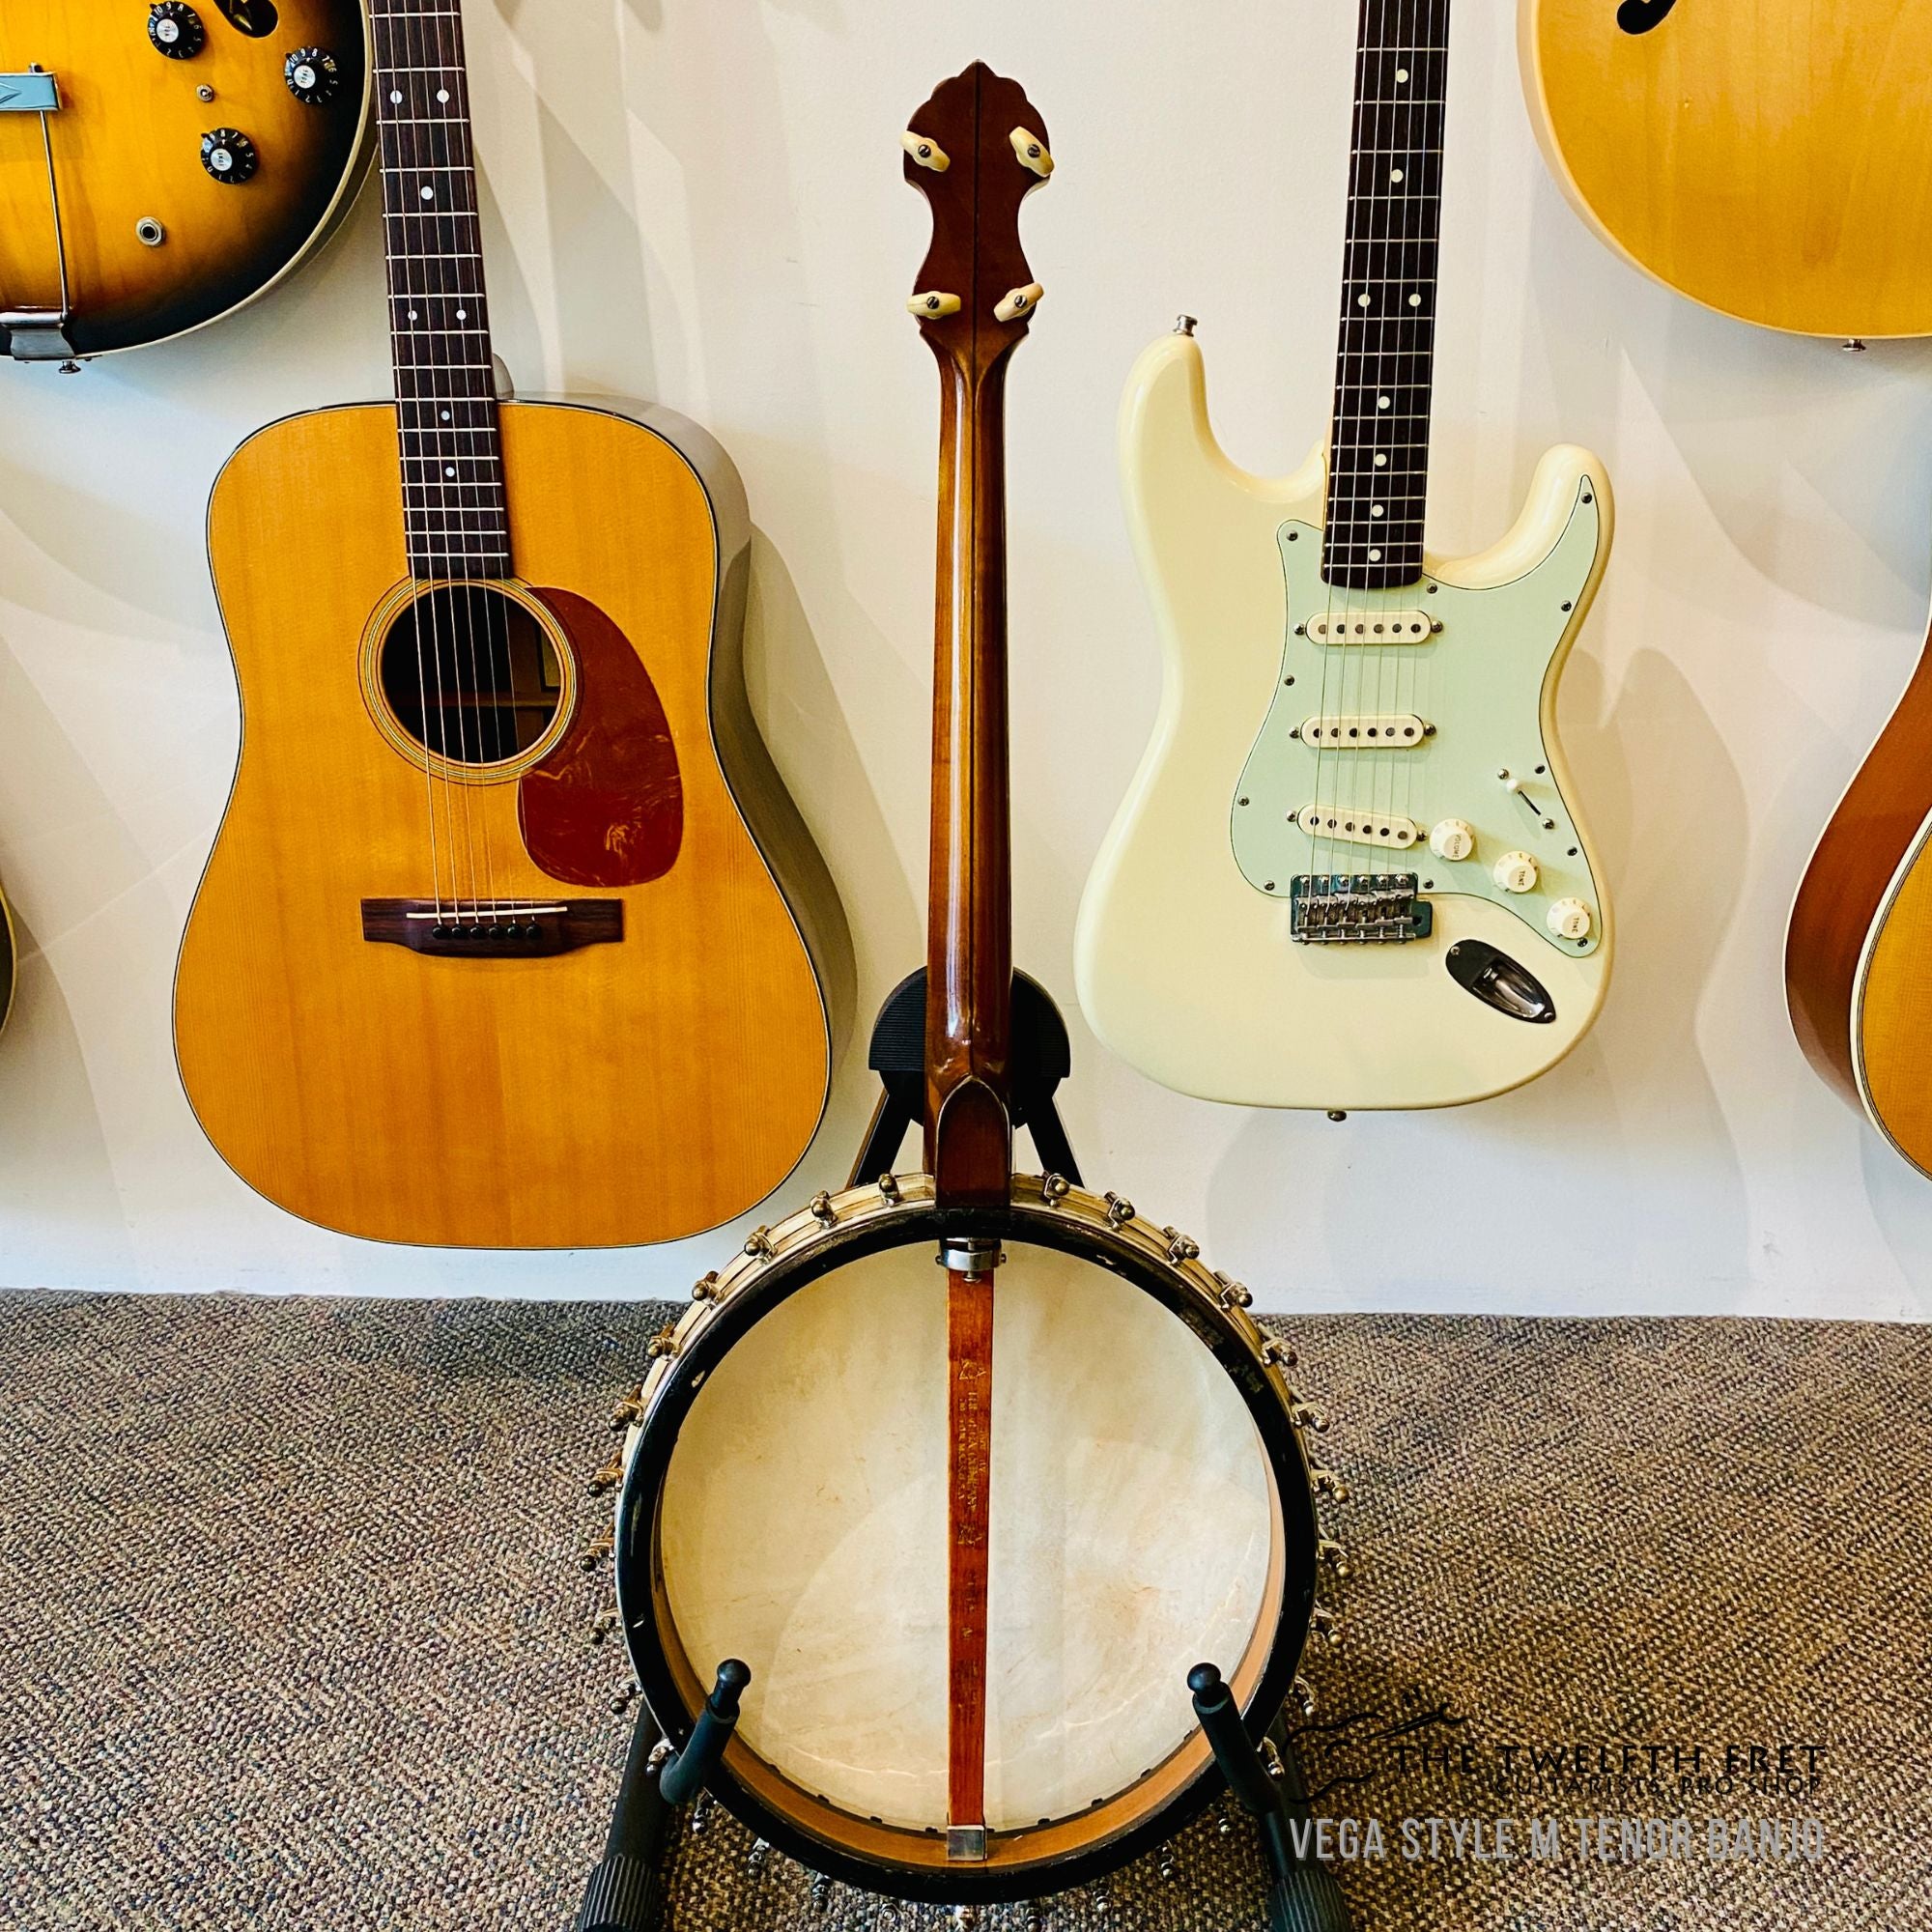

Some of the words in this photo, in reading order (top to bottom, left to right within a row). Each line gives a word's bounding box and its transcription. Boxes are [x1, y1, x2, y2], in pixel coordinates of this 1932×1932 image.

[1452, 833, 1462, 858] VOLUME
[1518, 870, 1526, 886] TONE
[1571, 917, 1579, 933] TONE
